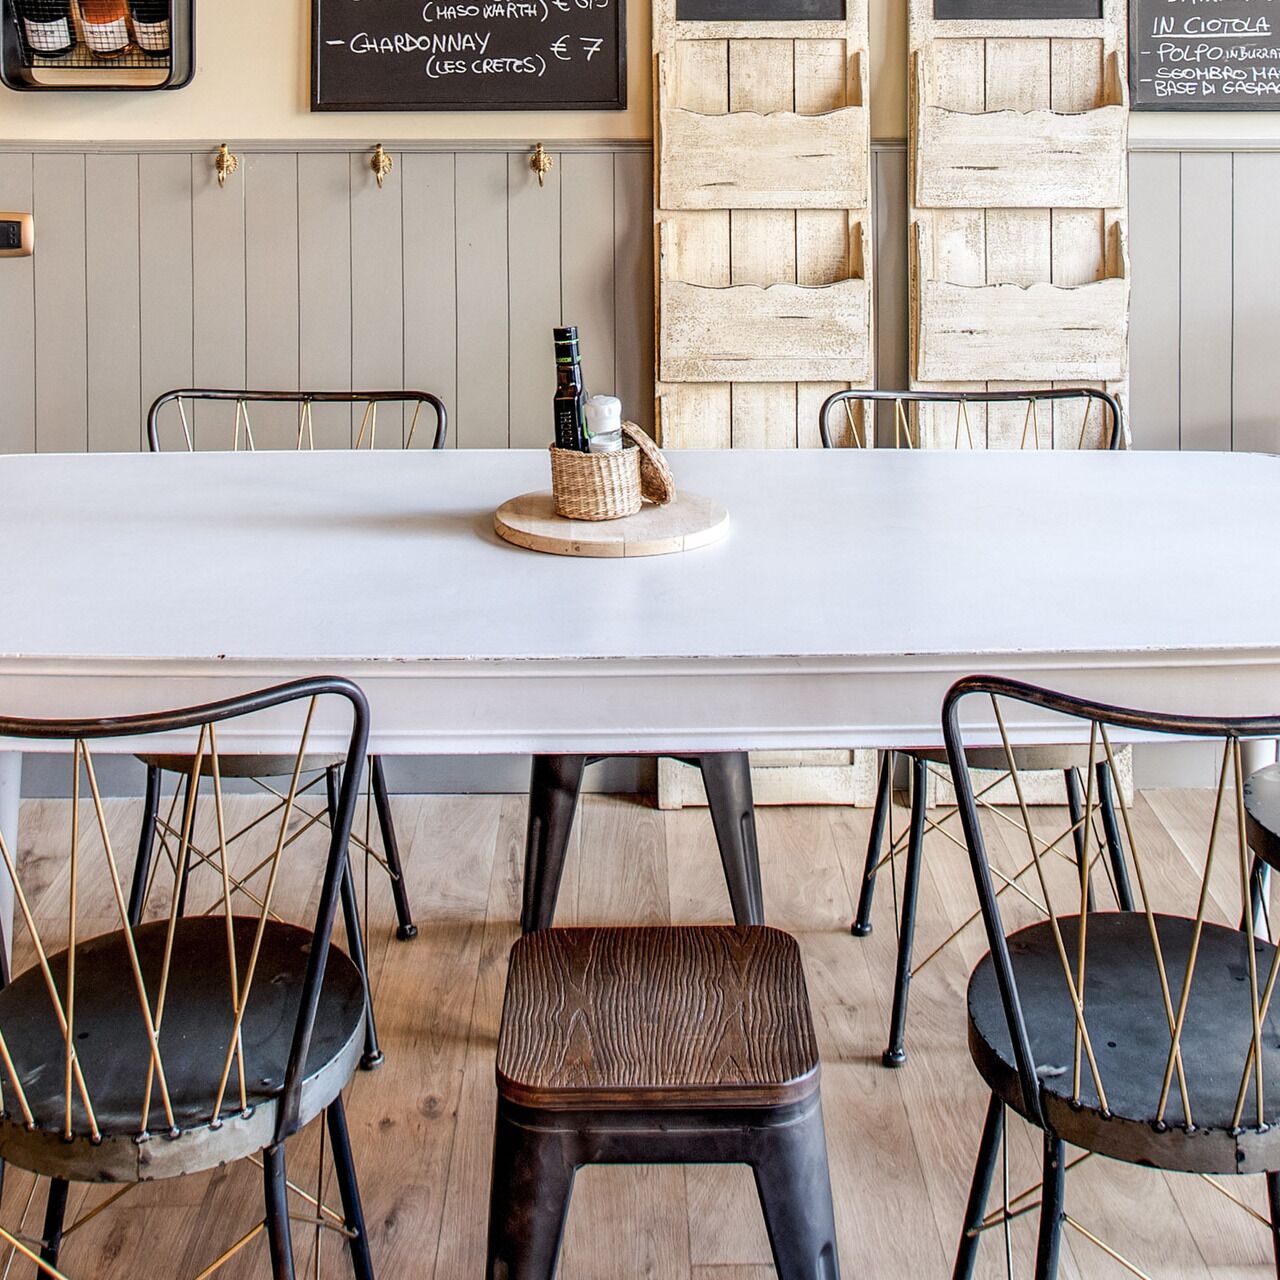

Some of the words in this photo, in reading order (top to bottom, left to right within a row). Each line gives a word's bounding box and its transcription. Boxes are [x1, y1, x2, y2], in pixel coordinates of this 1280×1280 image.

[1153, 16, 1175, 35] IN
[1183, 16, 1271, 33] CIOTOLA
[349, 32, 491, 55] CHARDONNAY
[1156, 42, 1224, 63] POLPO
[425, 55, 467, 79] (LES
[1155, 65, 1248, 80] SGOMBRO
[1154, 80, 1198, 97] BASE
[1202, 81, 1216, 96] DI
